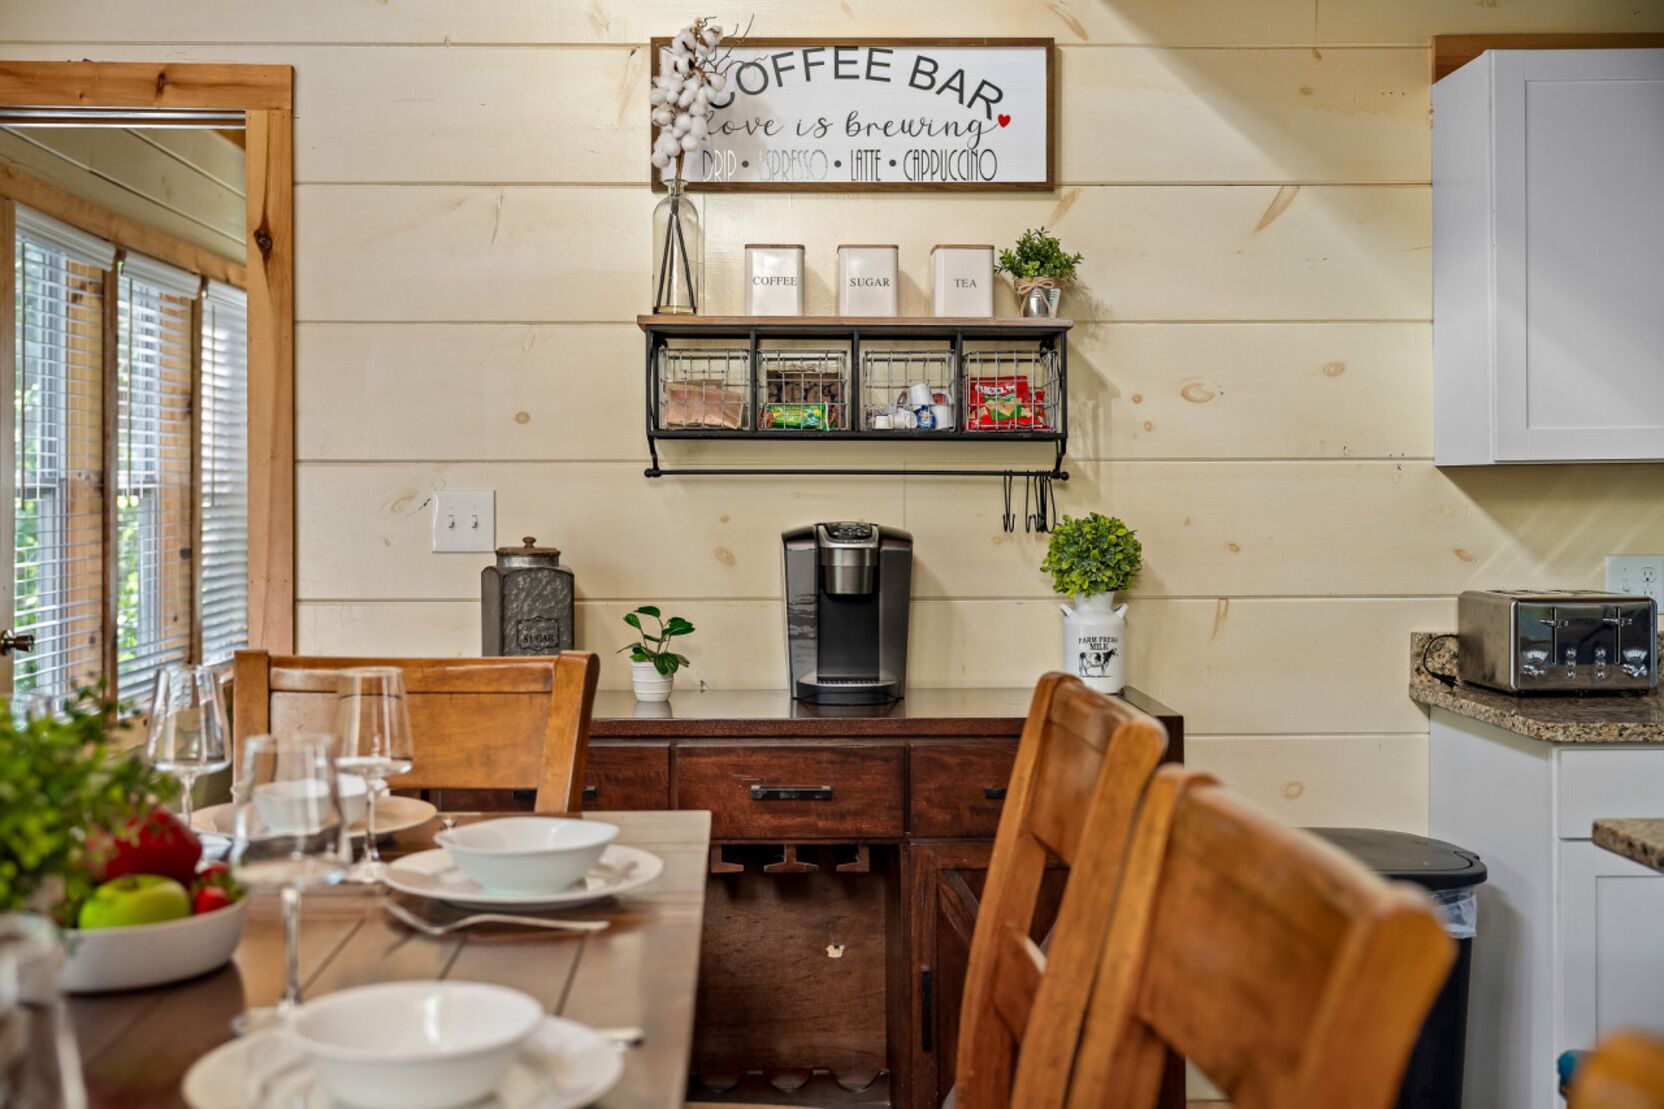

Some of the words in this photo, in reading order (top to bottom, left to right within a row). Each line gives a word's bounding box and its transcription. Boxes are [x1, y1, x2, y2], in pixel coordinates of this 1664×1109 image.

[908, 55, 1003, 120] BAR
[796, 117, 833, 138] is
[846, 110, 999, 150] brewing
[702, 150, 737, 182] DRIP
[761, 149, 829, 182] SPRESSO
[850, 149, 881, 182] LATTE
[903, 149, 998, 182] CAPPUCCINO
[752, 276, 798, 286] COFFEE
[850, 277, 890, 287] SUGAR
[954, 278, 977, 288] TEA
[522, 634, 555, 643] SUGAR
[1078, 636, 1097, 644] FARM
